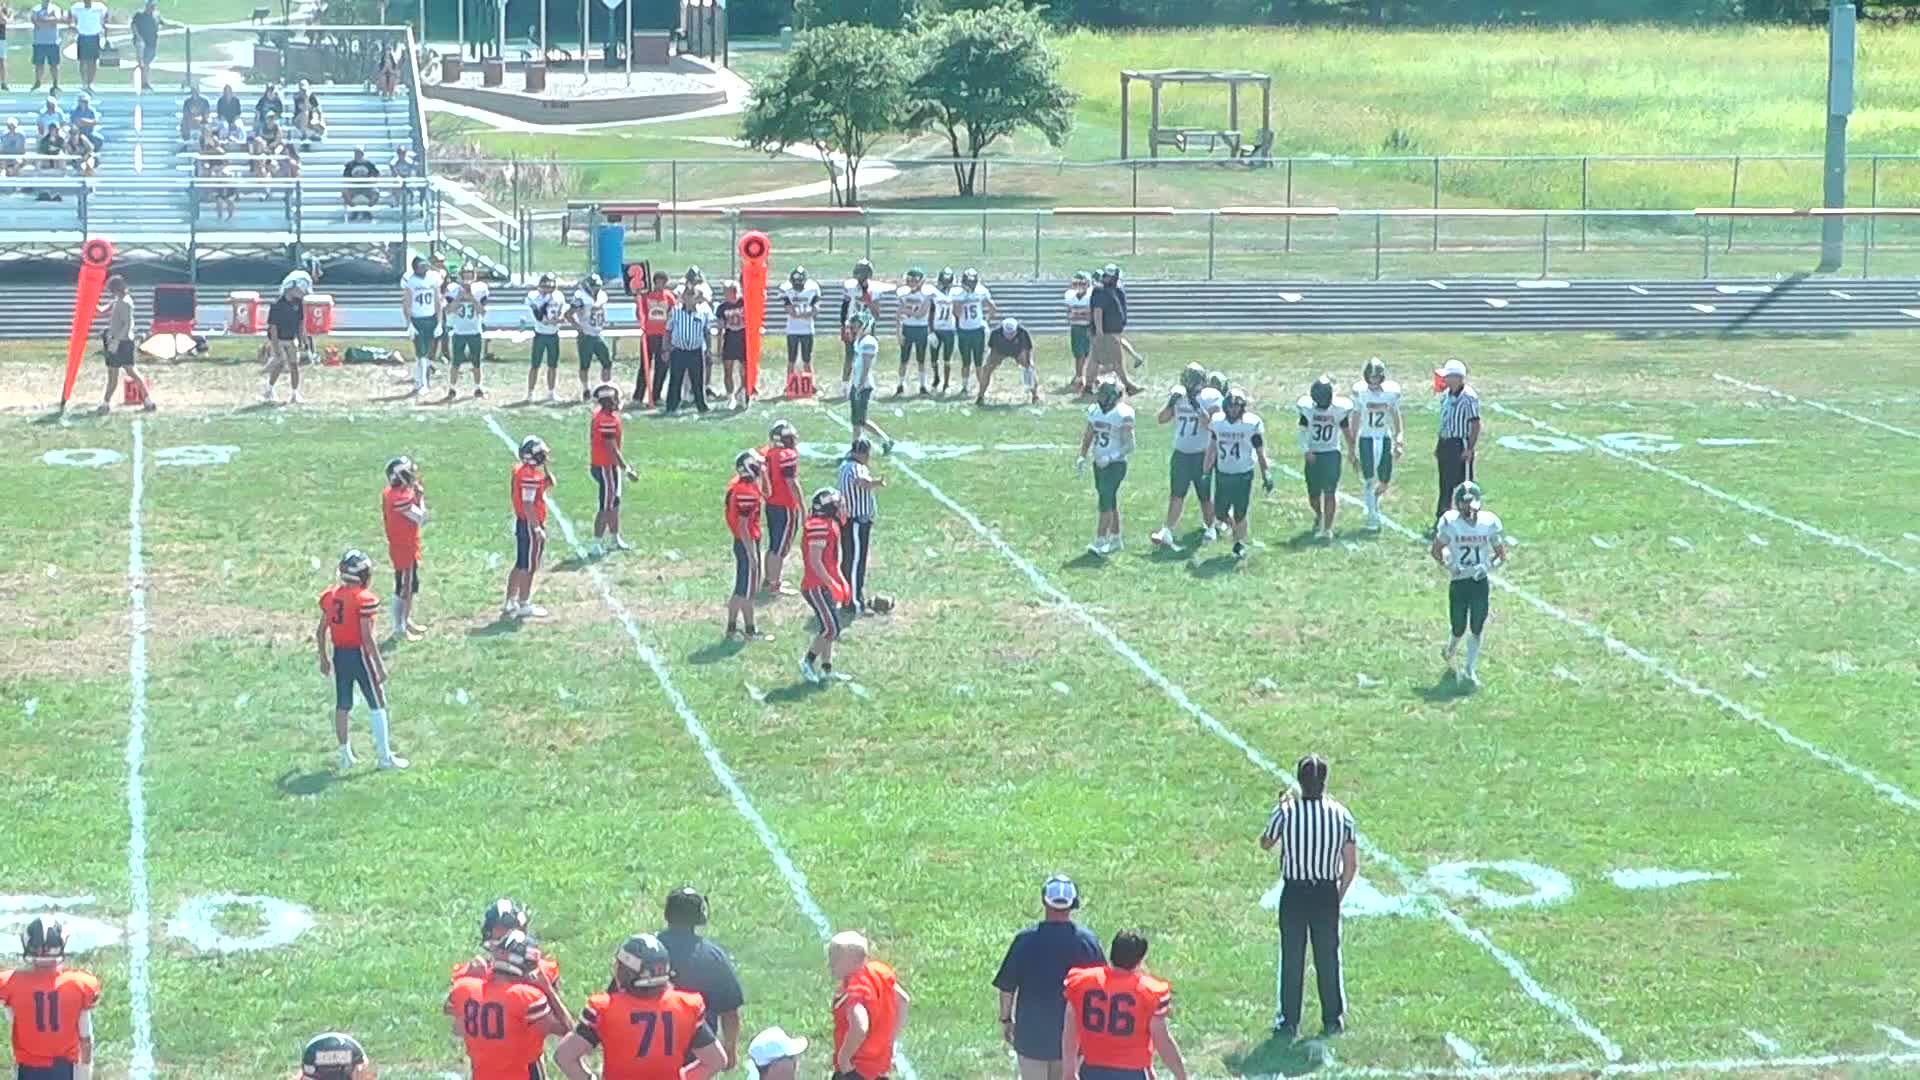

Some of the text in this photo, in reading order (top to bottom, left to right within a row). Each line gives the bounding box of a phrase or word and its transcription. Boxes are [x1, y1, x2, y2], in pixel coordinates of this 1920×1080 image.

[627, 263, 646, 289] 2
[416, 292, 432, 306] 40
[963, 305, 978, 320] 15
[788, 374, 811, 395] 40
[1178, 415, 1200, 437] 77
[1368, 411, 1386, 428] 12
[1312, 423, 1334, 442] 30
[1217, 440, 1241, 461] 54
[1458, 545, 1482, 566] 21
[34, 991, 60, 1033] 11
[463, 998, 505, 1040] 80
[1082, 989, 1137, 1037] 66
[629, 1010, 673, 1058] 71
